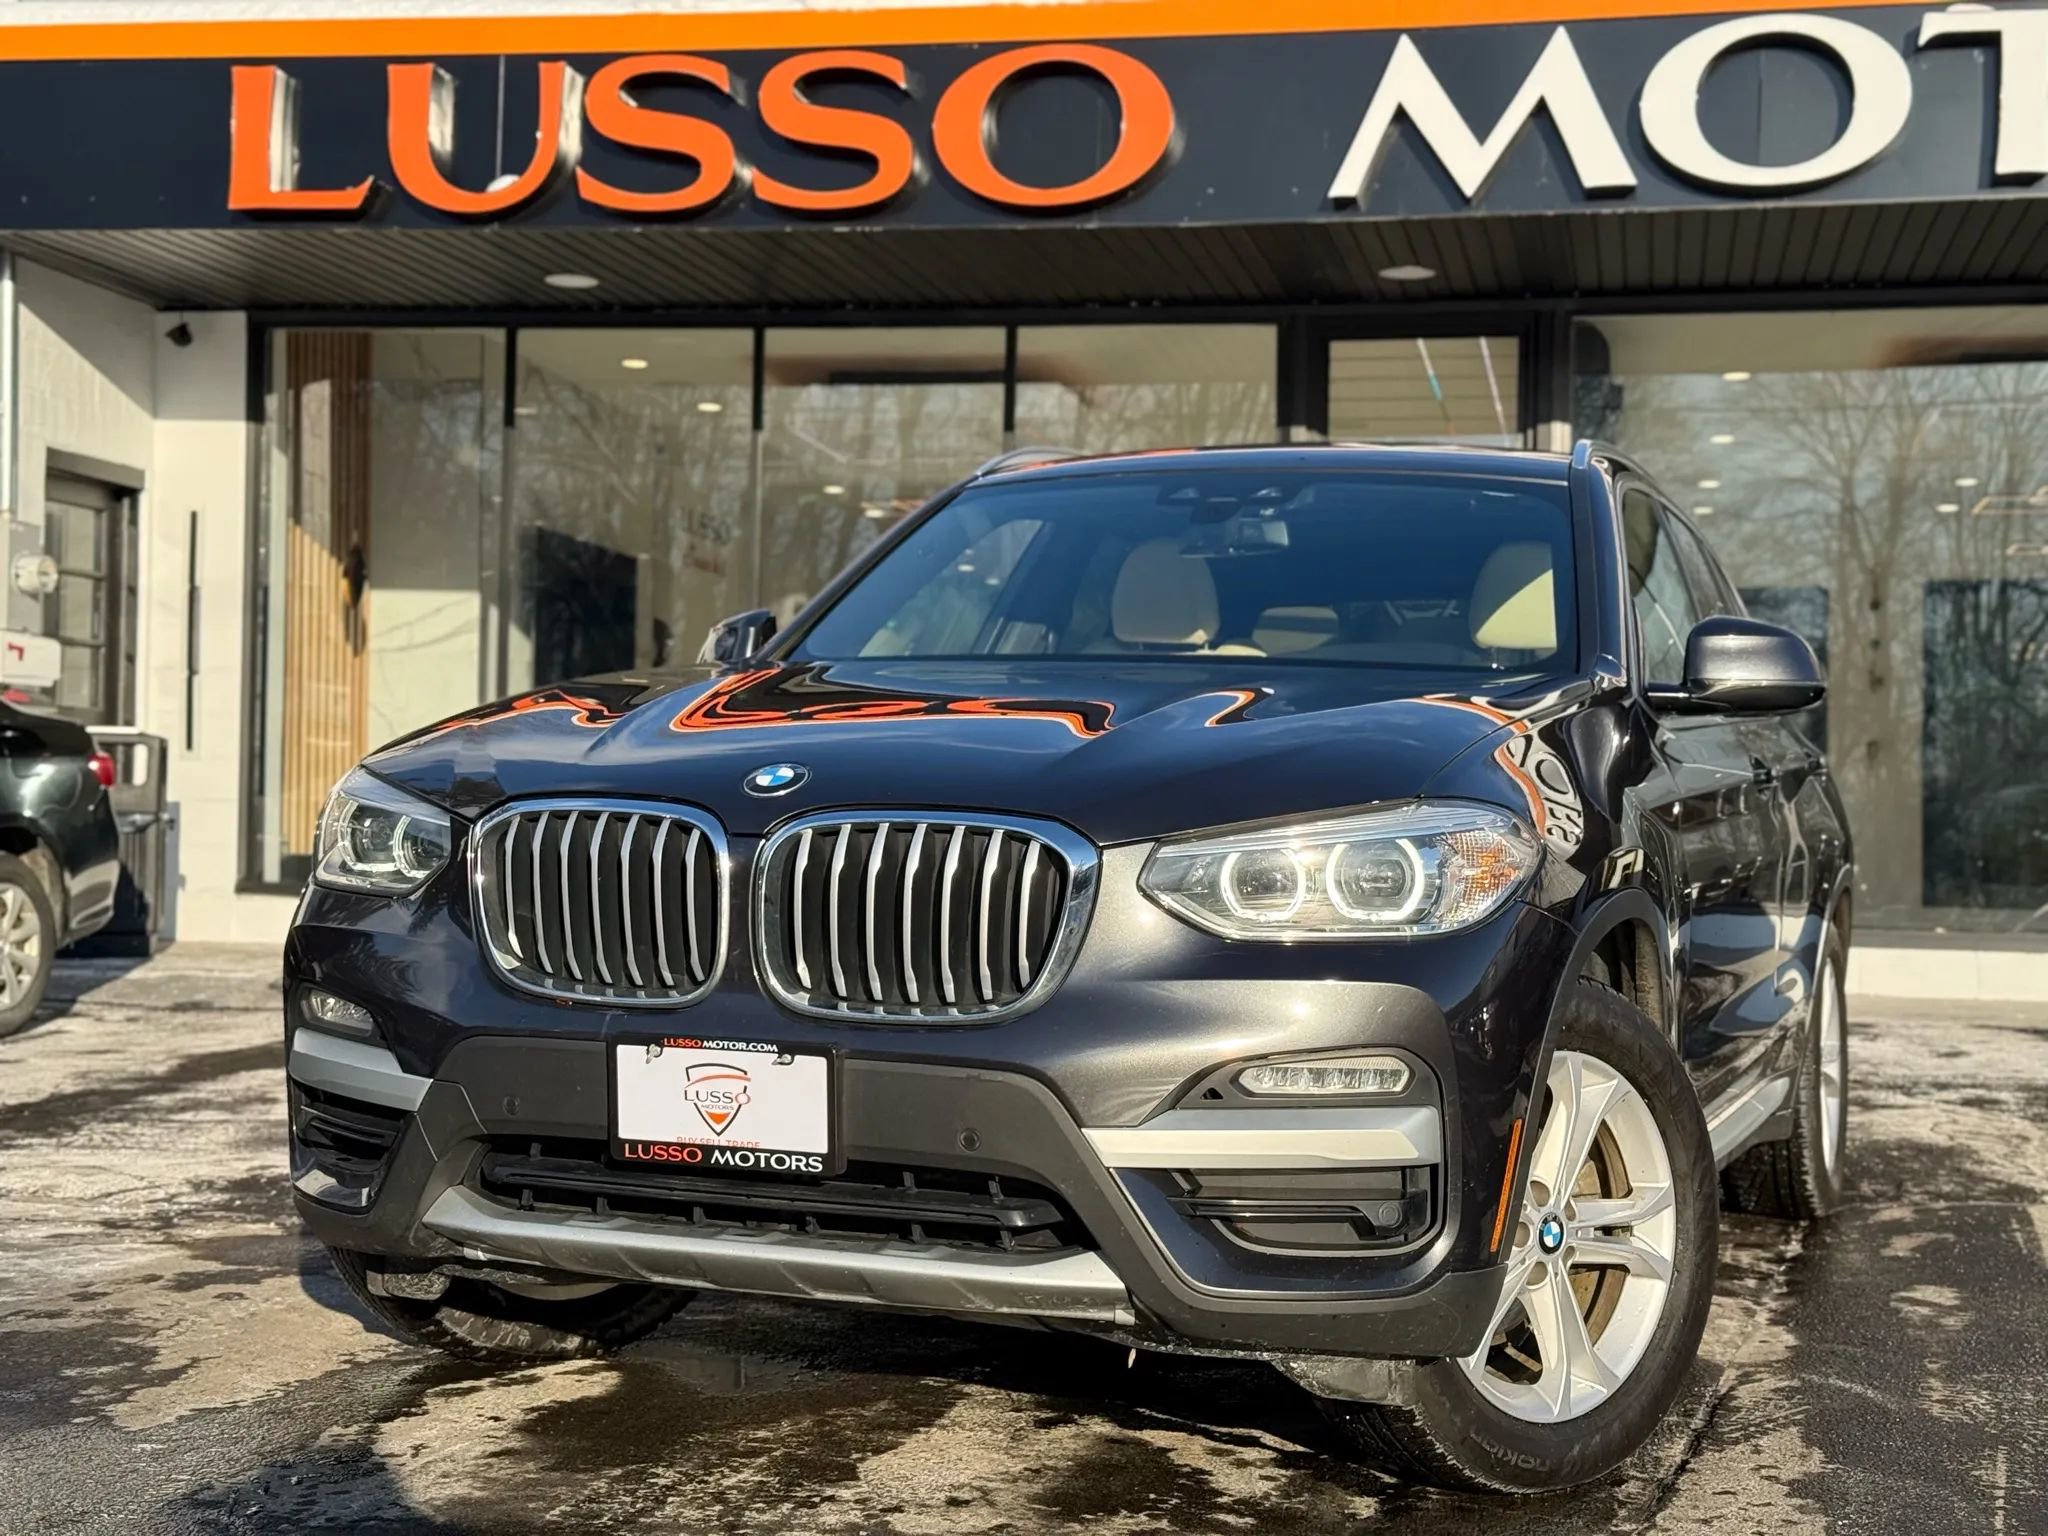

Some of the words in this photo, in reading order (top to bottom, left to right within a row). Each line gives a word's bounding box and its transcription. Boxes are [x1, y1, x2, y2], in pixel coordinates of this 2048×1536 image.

[228, 44, 1174, 213] LUSSO
[684, 1089, 751, 1105] LUSSO
[700, 1103, 734, 1111] MOTORS
[676, 1136, 698, 1144] BUY
[699, 1138, 721, 1146] SELL
[726, 1139, 760, 1149] TRADE
[624, 1143, 702, 1163] LUSSO
[711, 1149, 823, 1172] MOTORS
